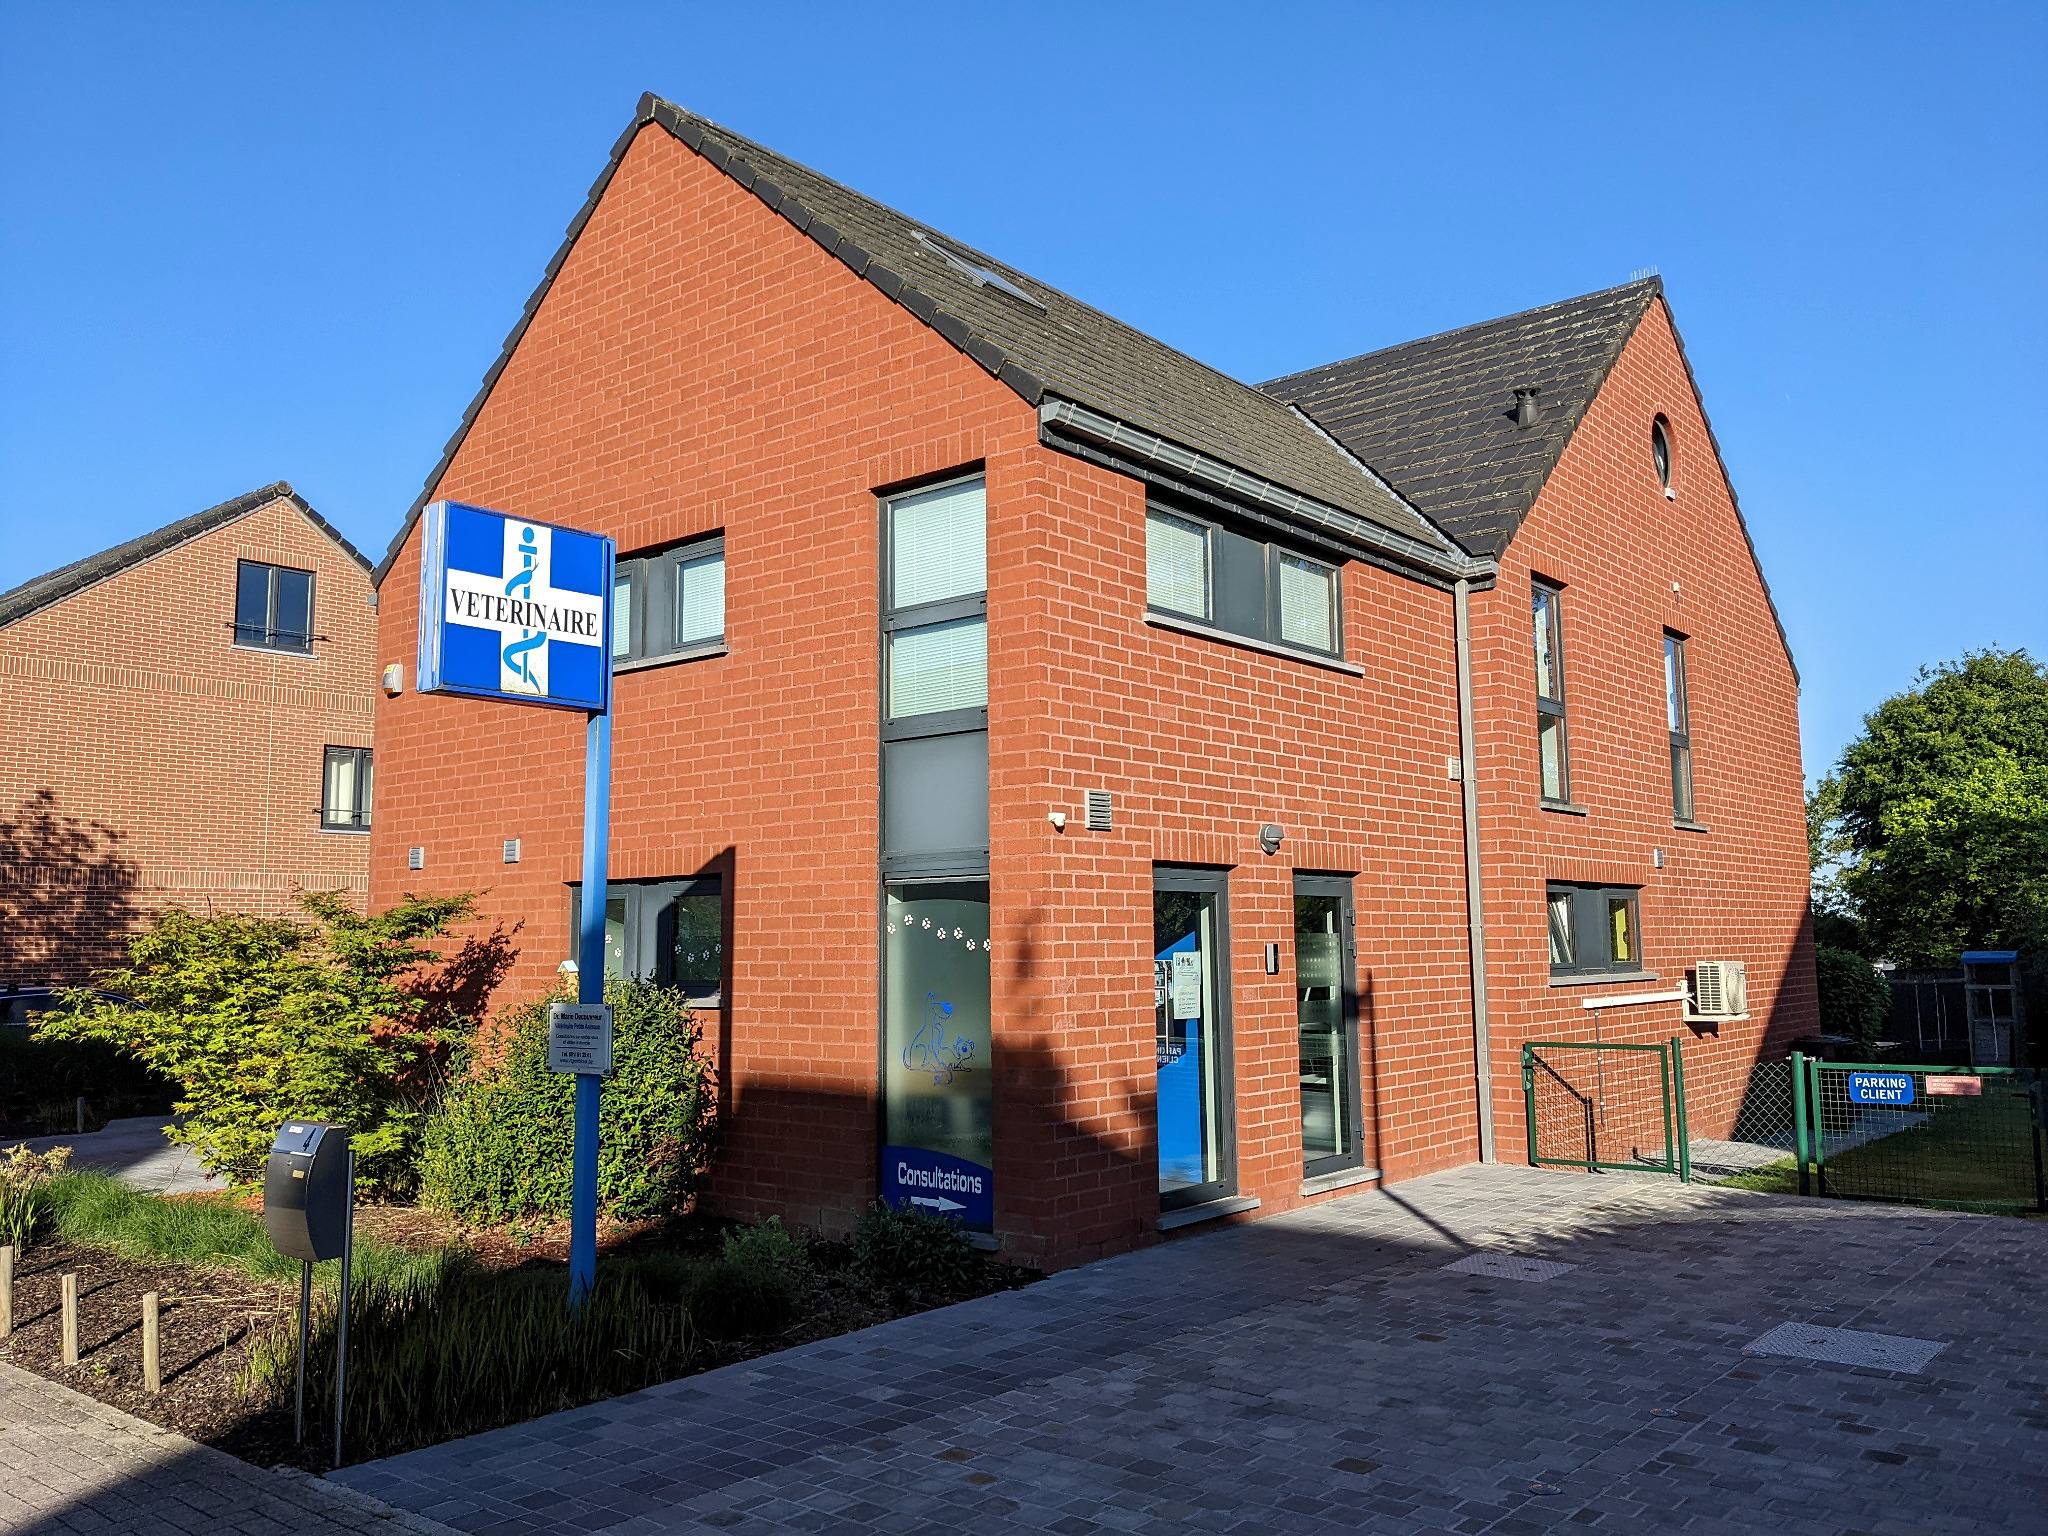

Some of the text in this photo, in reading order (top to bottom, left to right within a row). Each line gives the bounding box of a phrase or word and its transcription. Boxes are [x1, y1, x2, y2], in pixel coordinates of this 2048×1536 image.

[450, 588, 598, 637] VETERINAIRE
[1855, 1077, 1907, 1089] PARKING
[1860, 1089, 1903, 1100] CLIENT
[897, 1162, 982, 1194] Consultations
